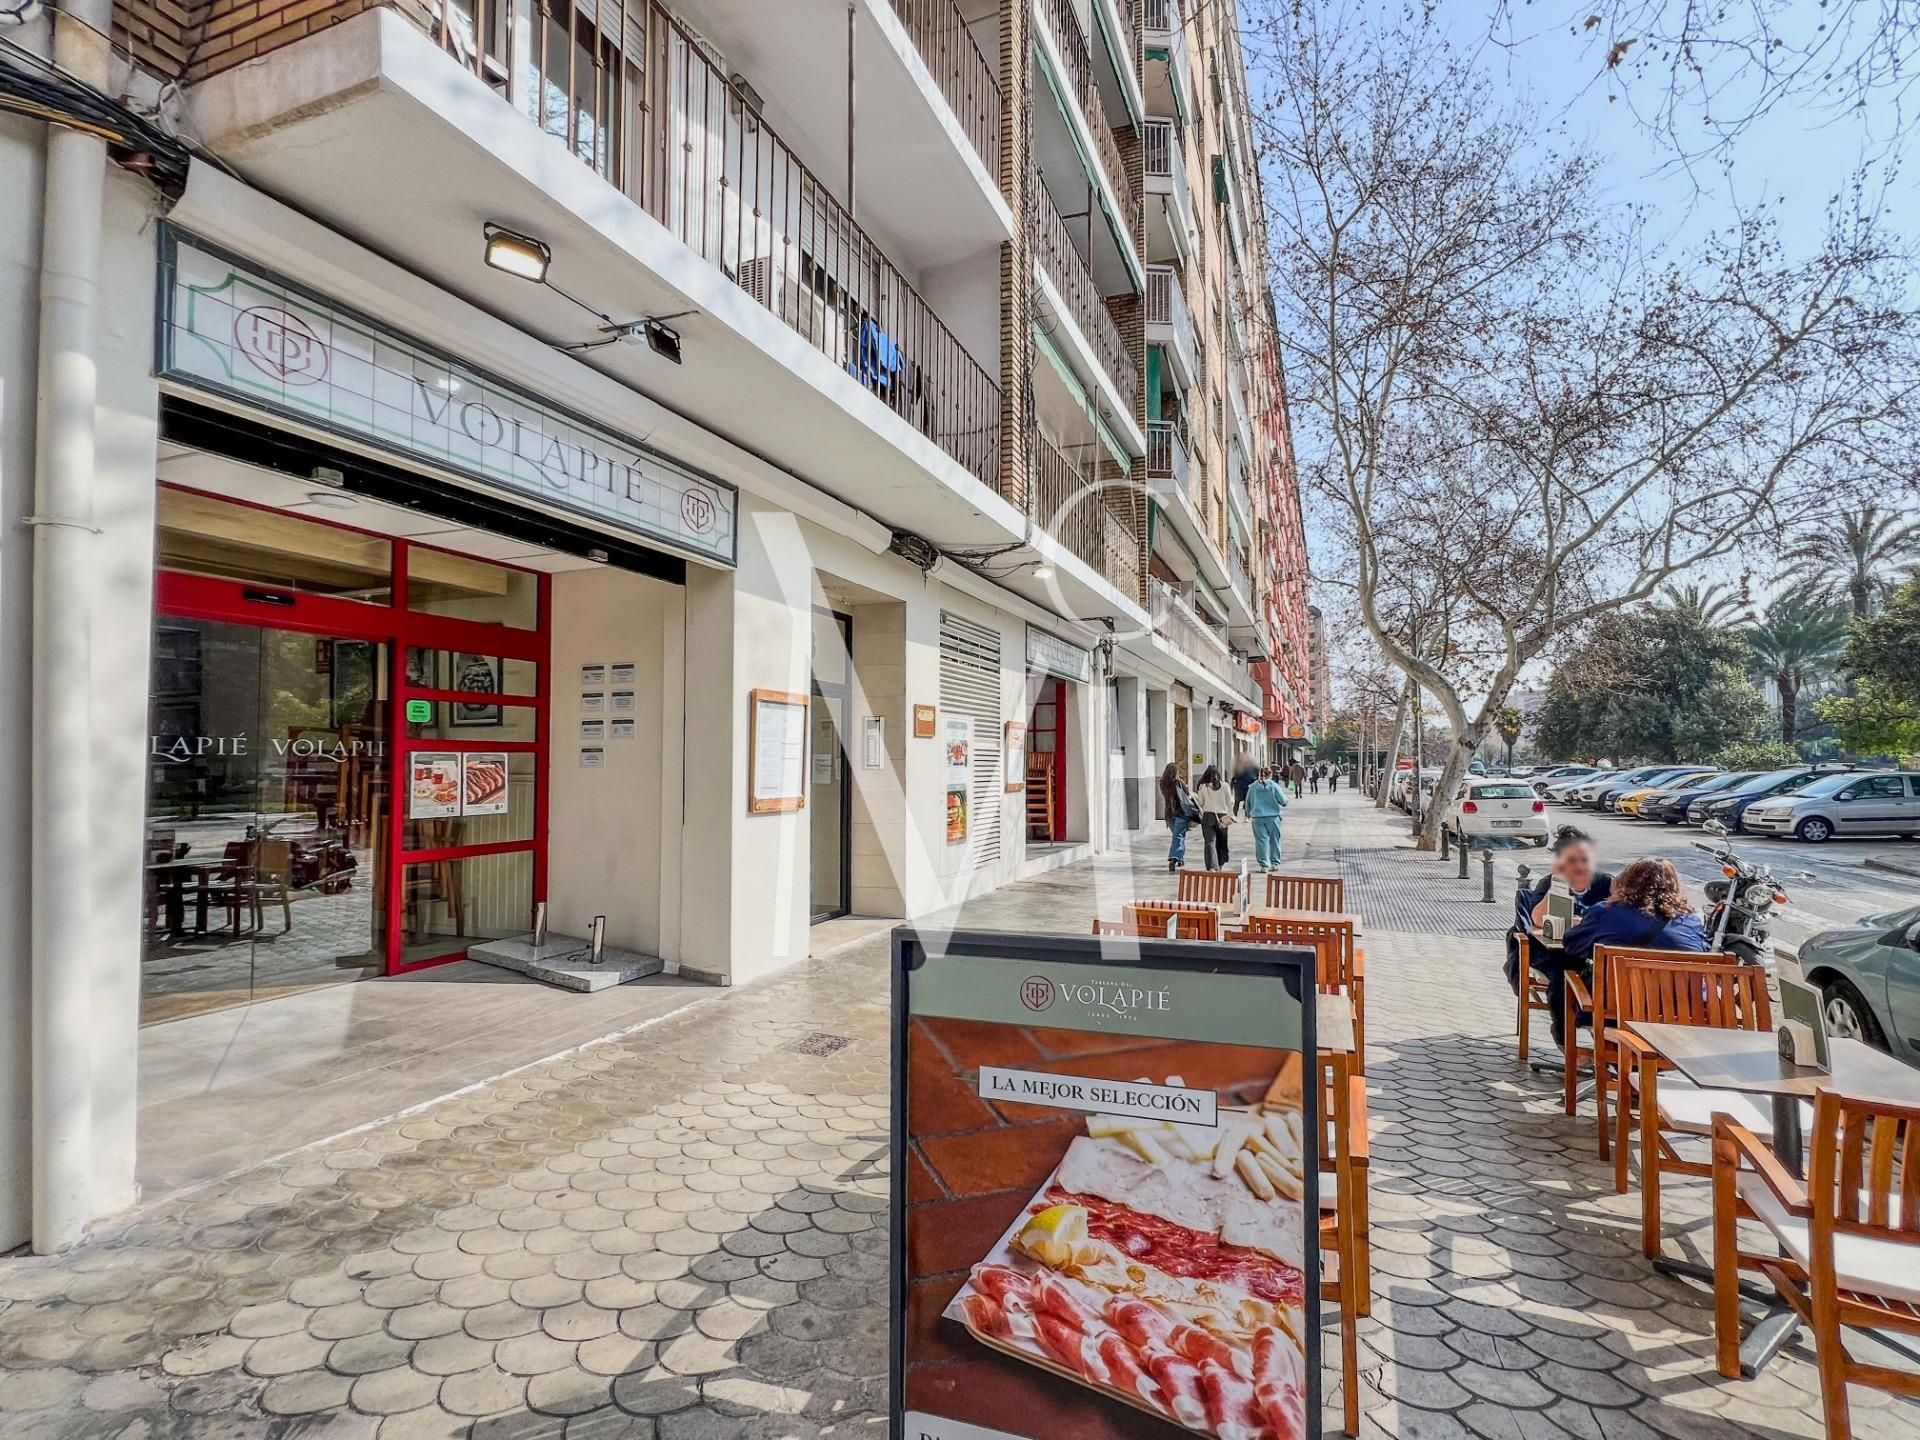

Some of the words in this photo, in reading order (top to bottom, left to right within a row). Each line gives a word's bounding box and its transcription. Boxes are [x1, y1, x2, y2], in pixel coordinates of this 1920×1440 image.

[412, 374, 644, 505] VOLAPIÉ
[1059, 984, 1171, 1015] VOLAPIÉ
[991, 1075, 1016, 1092] LA
[1022, 1079, 1085, 1100] MEJOR
[1089, 1087, 1202, 1113] SELECCIÓN
